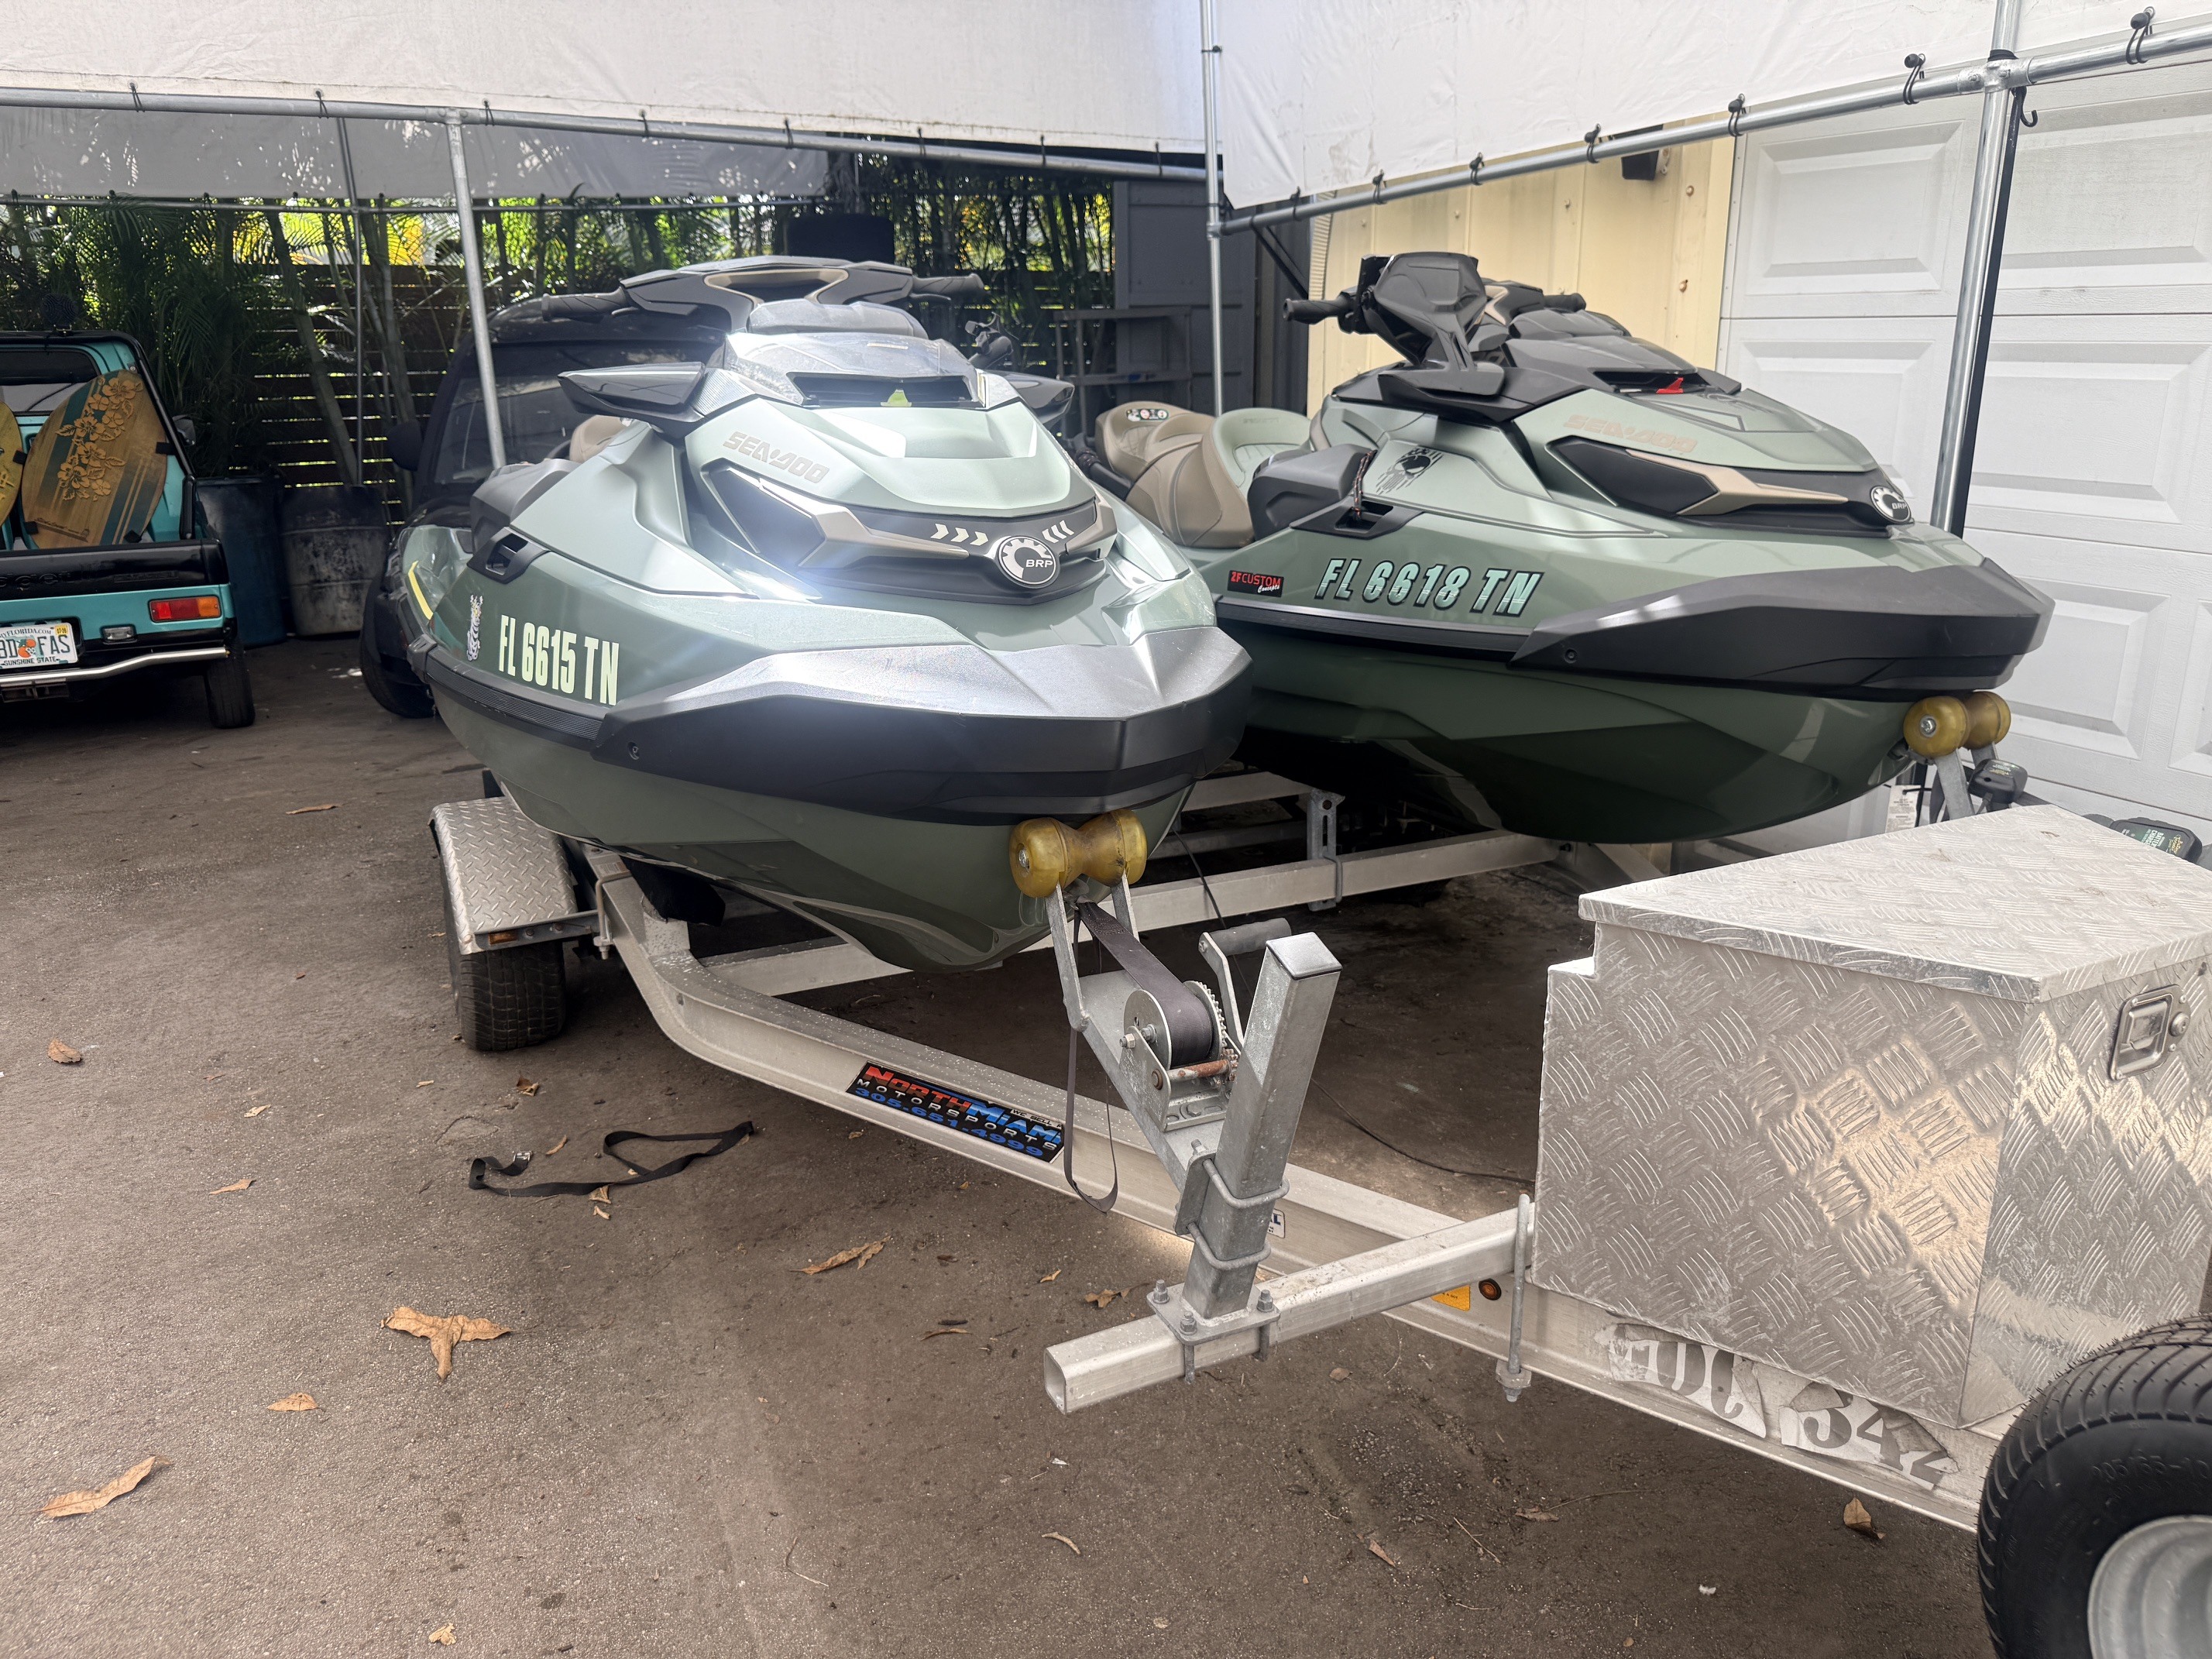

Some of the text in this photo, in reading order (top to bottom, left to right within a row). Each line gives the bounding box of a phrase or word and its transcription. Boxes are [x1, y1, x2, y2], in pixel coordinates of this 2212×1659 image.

[1025, 559, 1053, 568] BRP
[1314, 558, 1545, 617] FL 6618 TN
[37, 634, 70, 655] FAS
[499, 614, 620, 706] FL 6615 TN
[854, 1087, 1043, 1157] 305-651-4999
